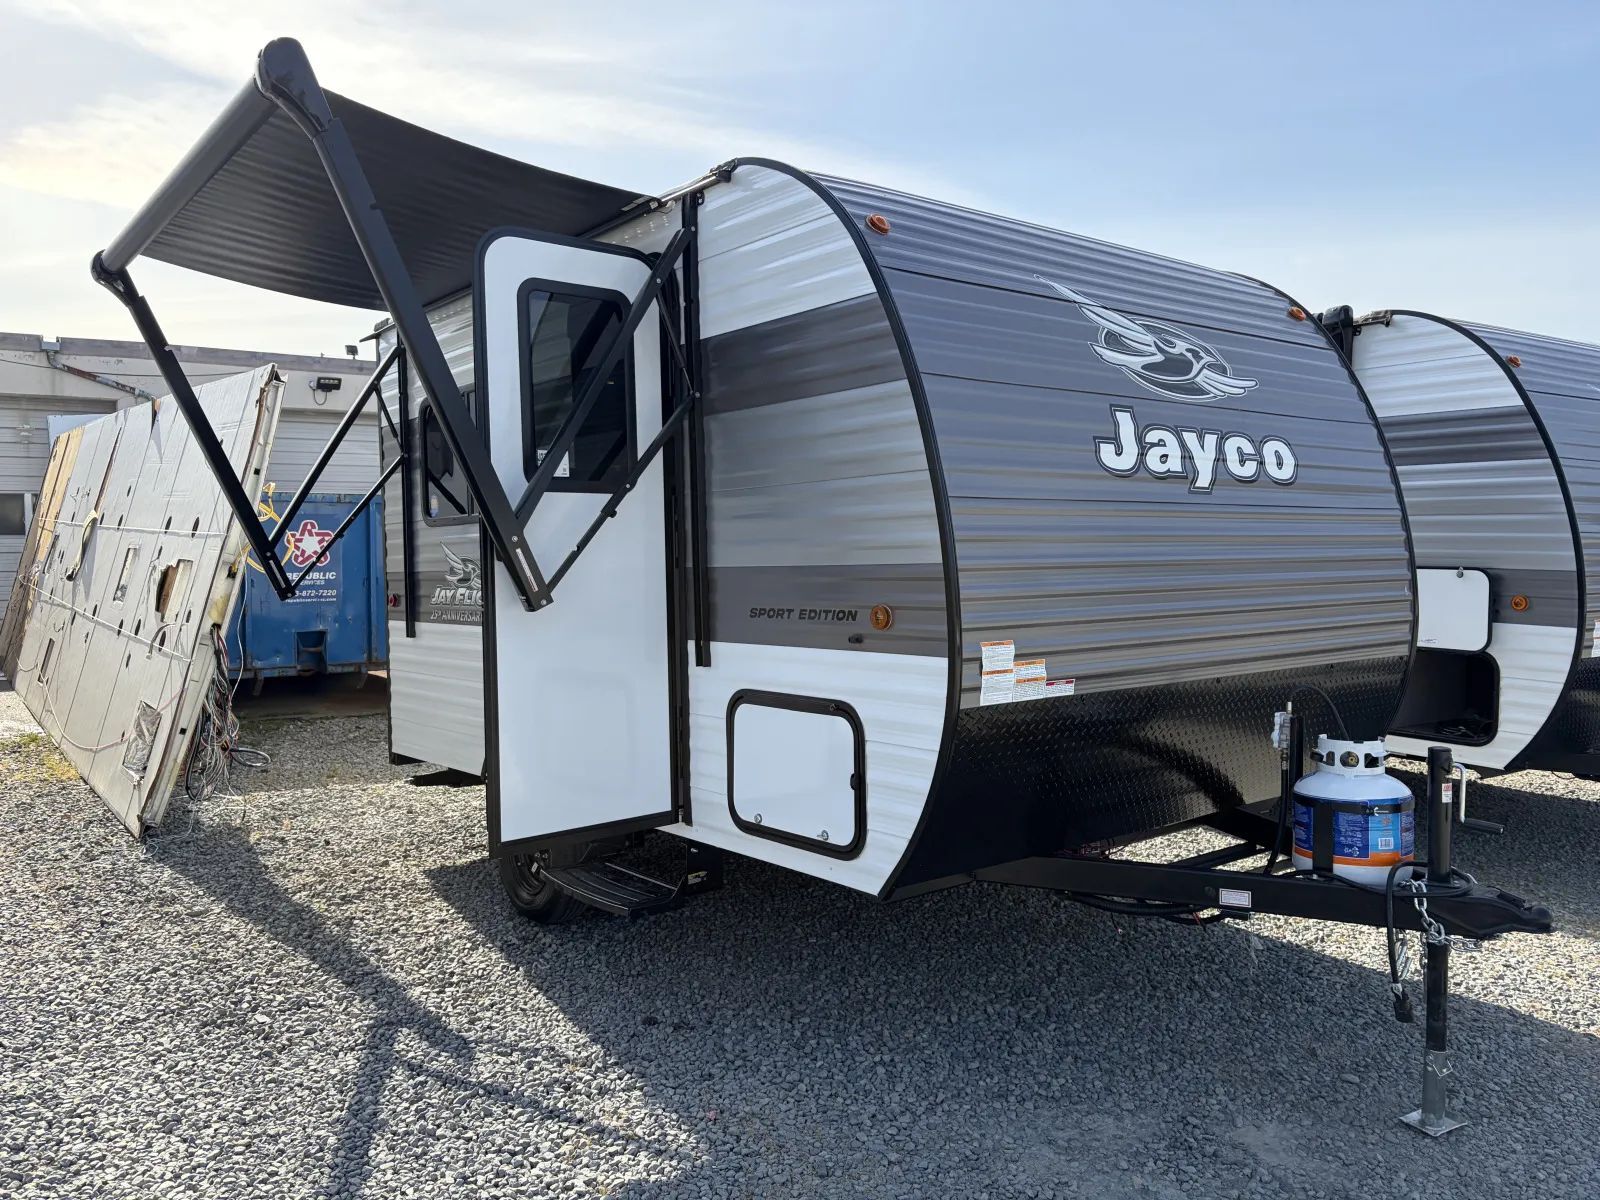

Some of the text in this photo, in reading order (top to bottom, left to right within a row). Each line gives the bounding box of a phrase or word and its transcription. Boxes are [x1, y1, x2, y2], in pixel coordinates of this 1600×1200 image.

[1094, 404, 1298, 494] Jayco
[430, 586, 456, 606] JAY
[441, 609, 483, 622] ANNIVERSAR
[749, 607, 859, 622] SPORT EDITION
